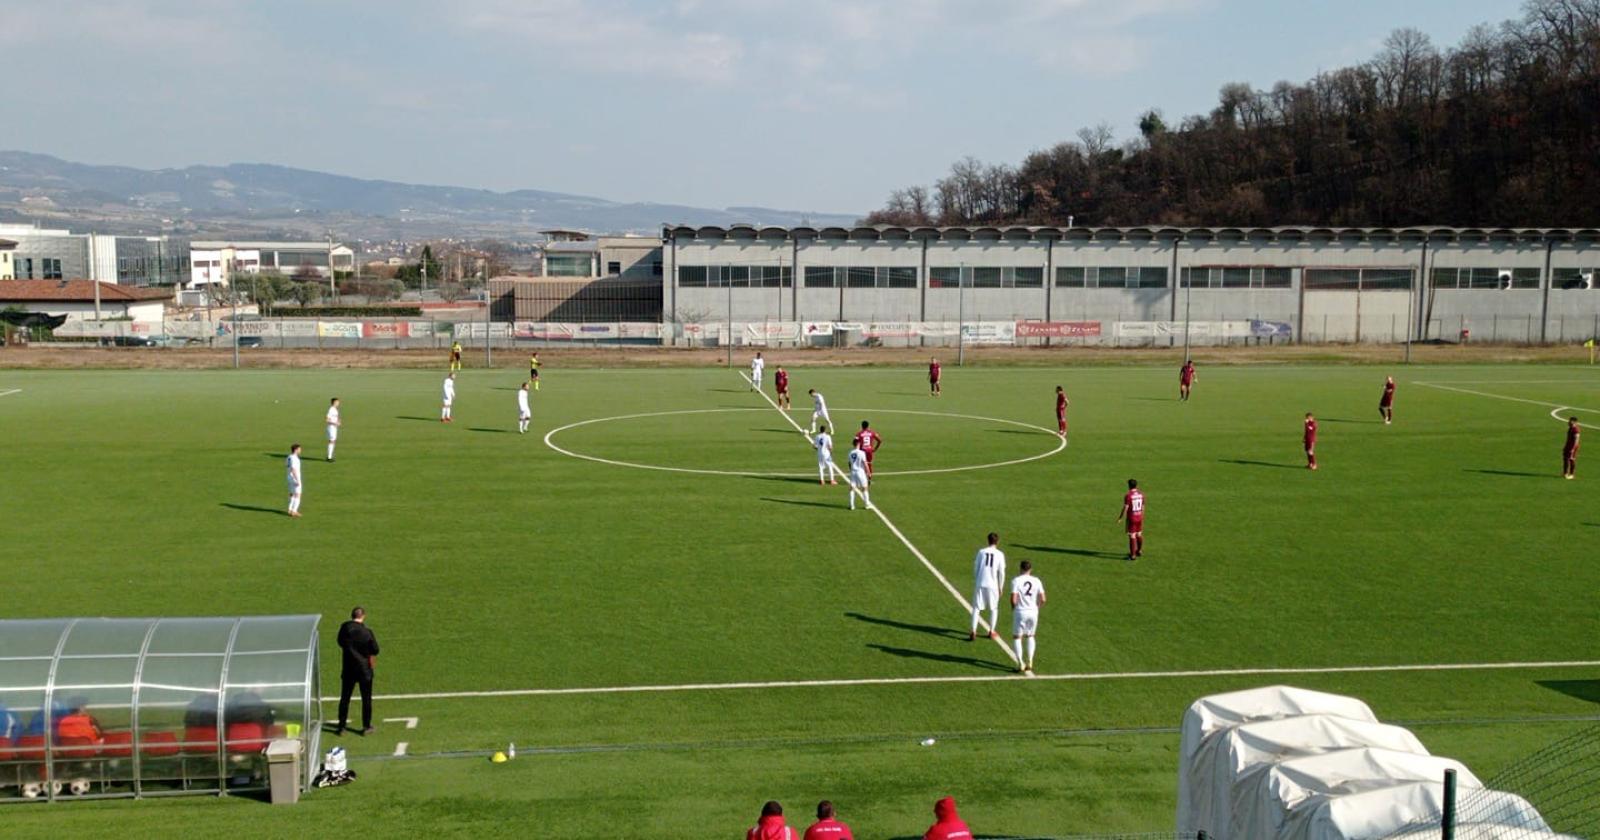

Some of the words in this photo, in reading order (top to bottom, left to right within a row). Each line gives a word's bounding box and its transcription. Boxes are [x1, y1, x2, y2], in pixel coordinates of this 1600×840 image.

[850, 452, 858, 463] 9
[1131, 498, 1143, 512] 10
[984, 552, 994, 568] 11
[1023, 580, 1033, 597] 2
